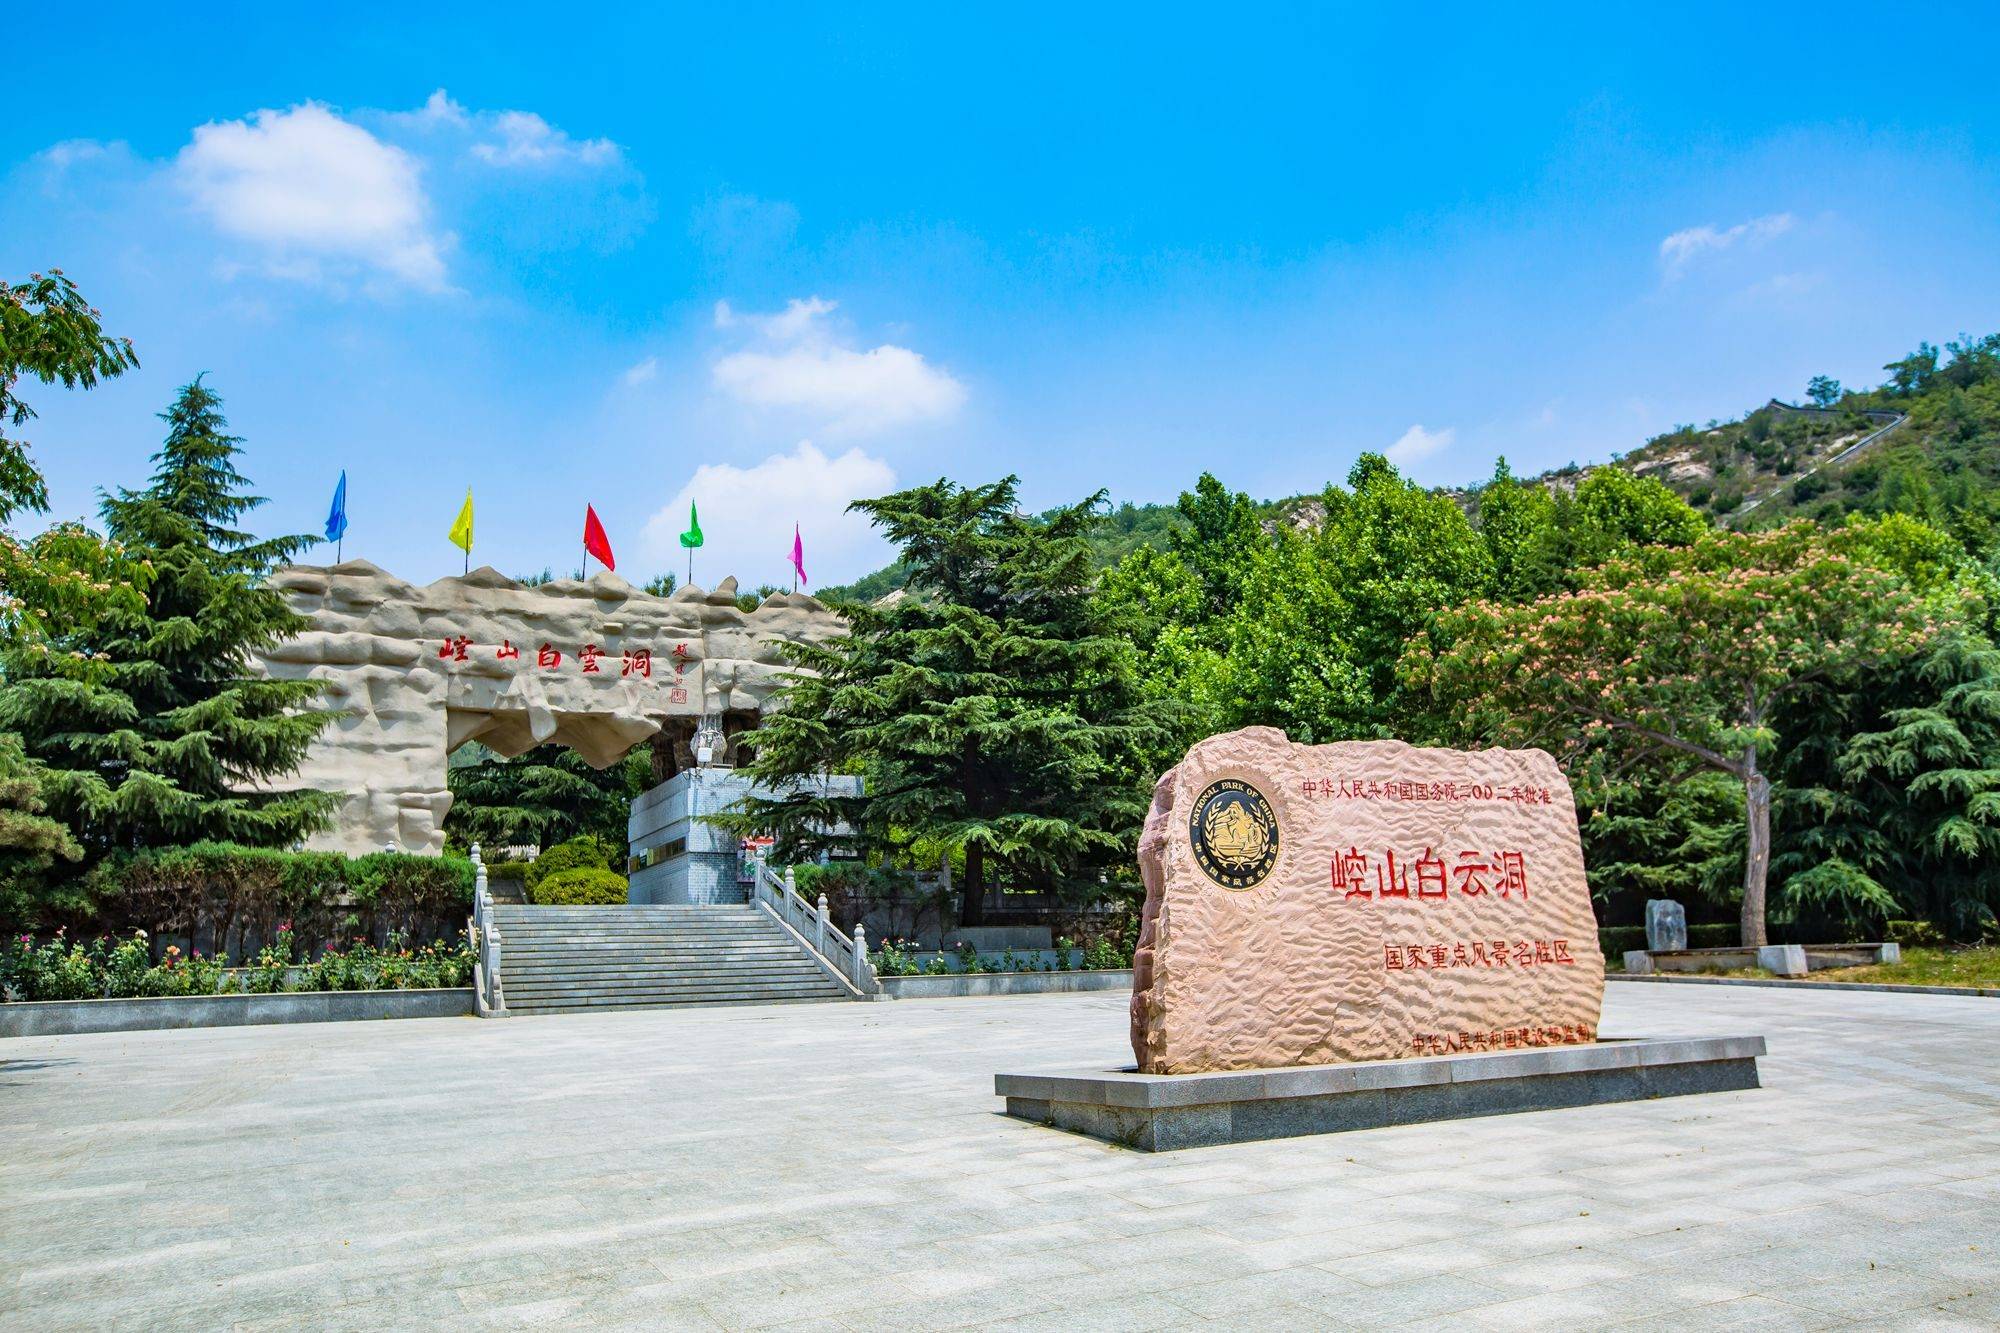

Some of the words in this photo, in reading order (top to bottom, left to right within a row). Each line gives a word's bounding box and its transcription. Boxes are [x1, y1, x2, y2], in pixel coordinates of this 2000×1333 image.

[1192, 786, 1220, 827] NATIONAL
[1221, 781, 1245, 792] PARK
[1246, 787, 1259, 798] OF
[1258, 799, 1276, 828] CHINA
[1331, 846, 1529, 901] 崆山白云洞
[1384, 939, 1575, 970] 国家重点风景名胜区
[1411, 1023, 1591, 1053] 中华人民共和国建设部监制
